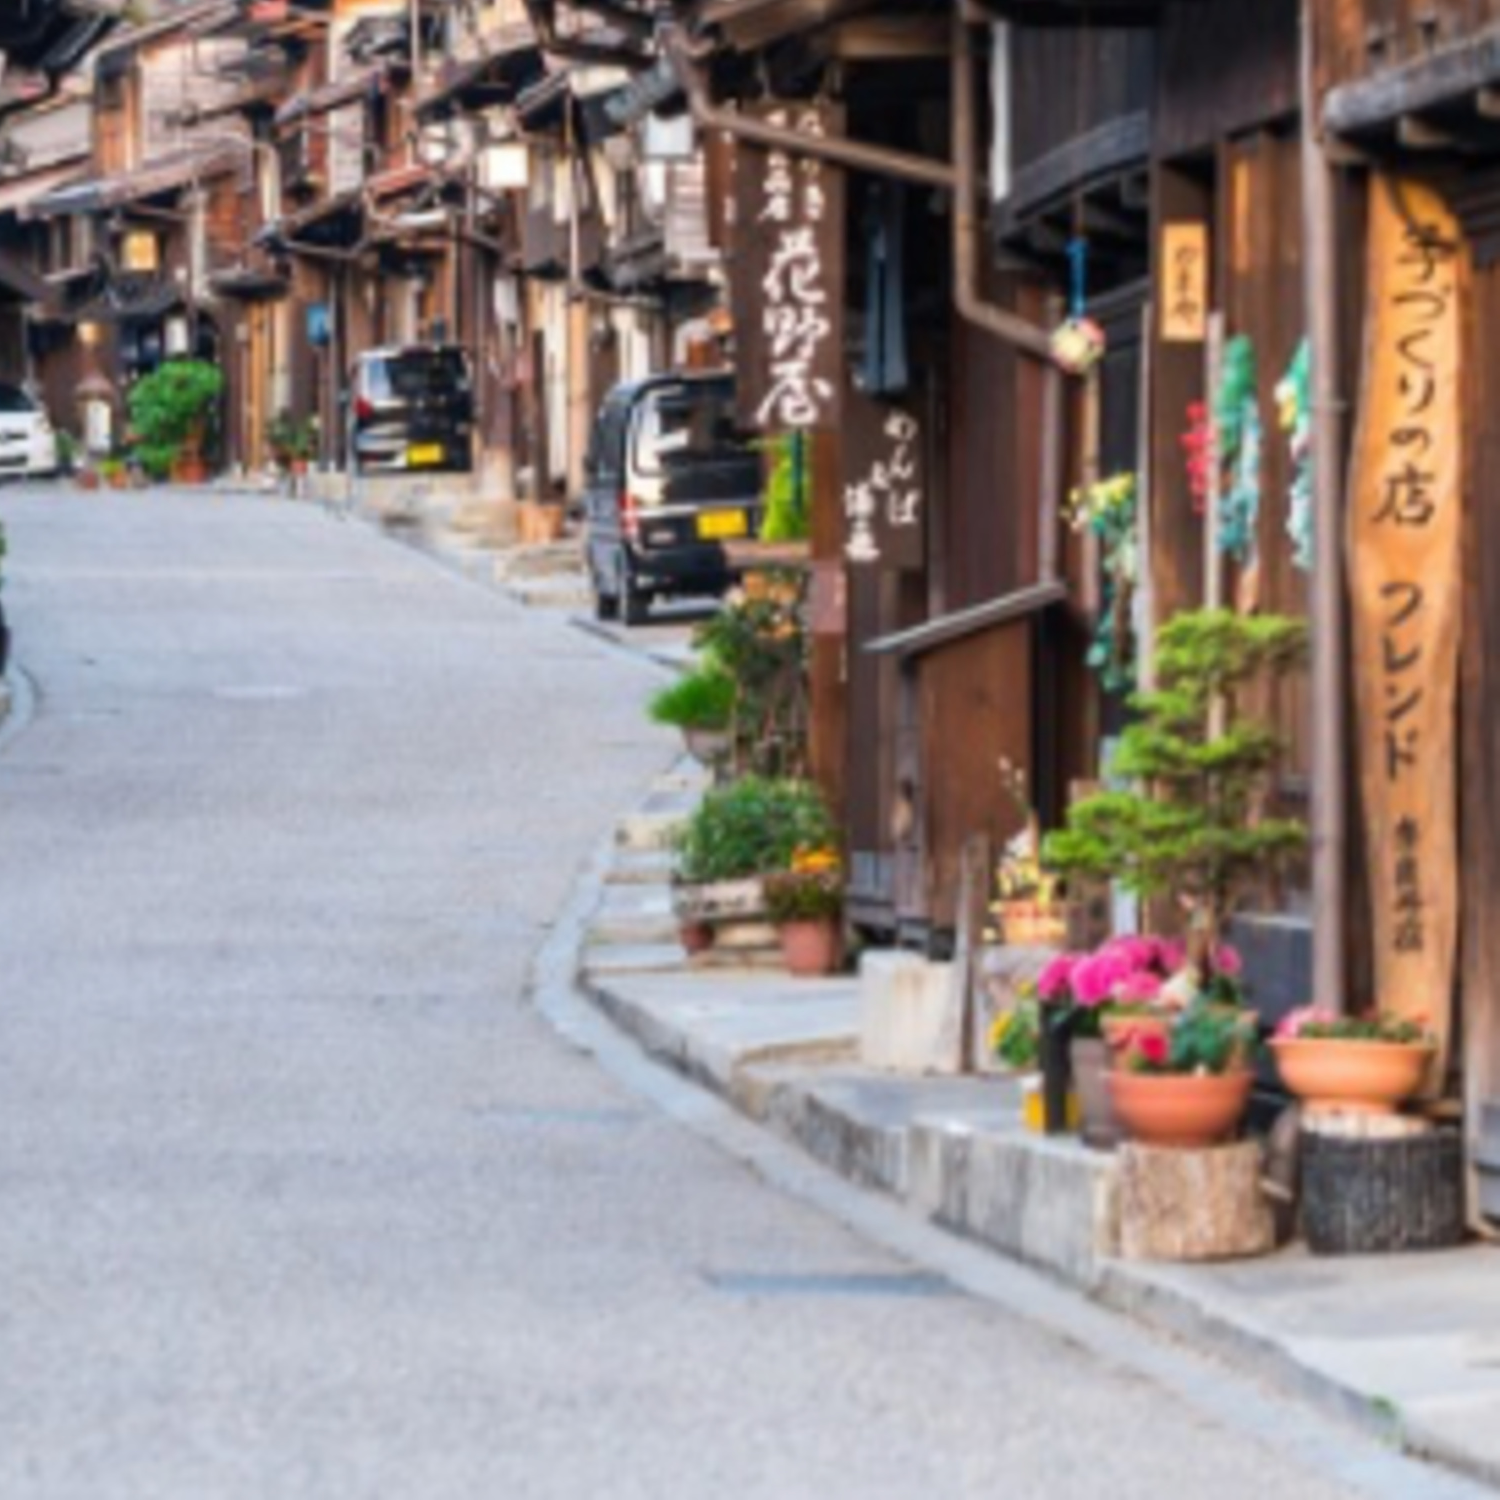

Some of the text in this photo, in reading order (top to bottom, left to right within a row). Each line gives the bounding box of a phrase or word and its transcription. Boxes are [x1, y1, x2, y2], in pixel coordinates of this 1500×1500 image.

[756, 222, 832, 426] 花野屋
[1370, 220, 1457, 526] 手づくりの店
[1379, 578, 1424, 782] フレンド
